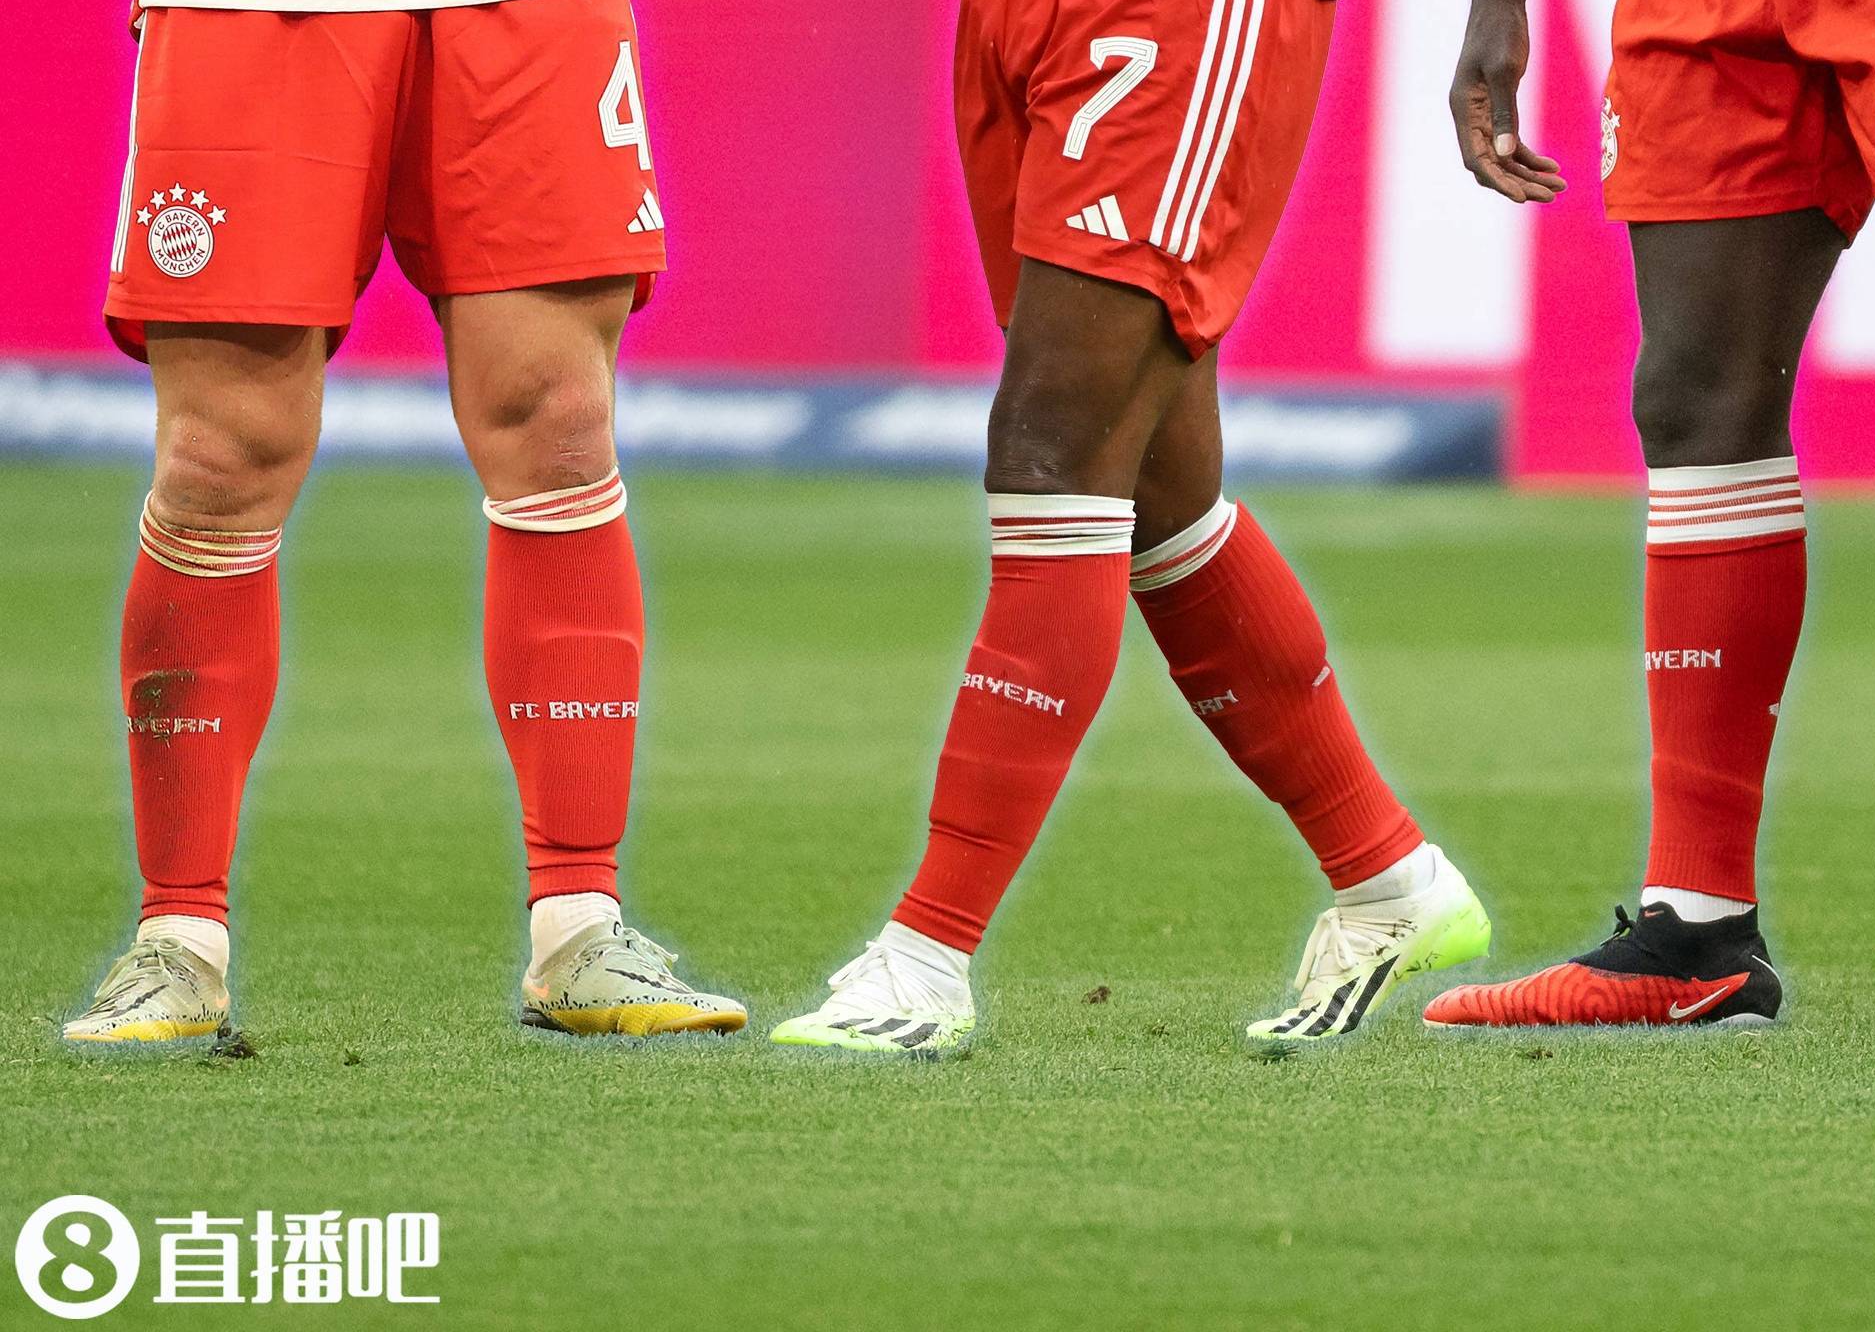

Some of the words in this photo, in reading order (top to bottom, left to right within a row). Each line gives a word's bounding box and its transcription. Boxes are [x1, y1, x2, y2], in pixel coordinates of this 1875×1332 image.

[598, 40, 652, 171] 4
[1062, 36, 1158, 160] 7
[154, 221, 165, 237] FC
[165, 212, 206, 237] BAYERN
[1645, 649, 1721, 671] AYERN
[509, 703, 540, 719] FC
[548, 701, 640, 719] BAYER
